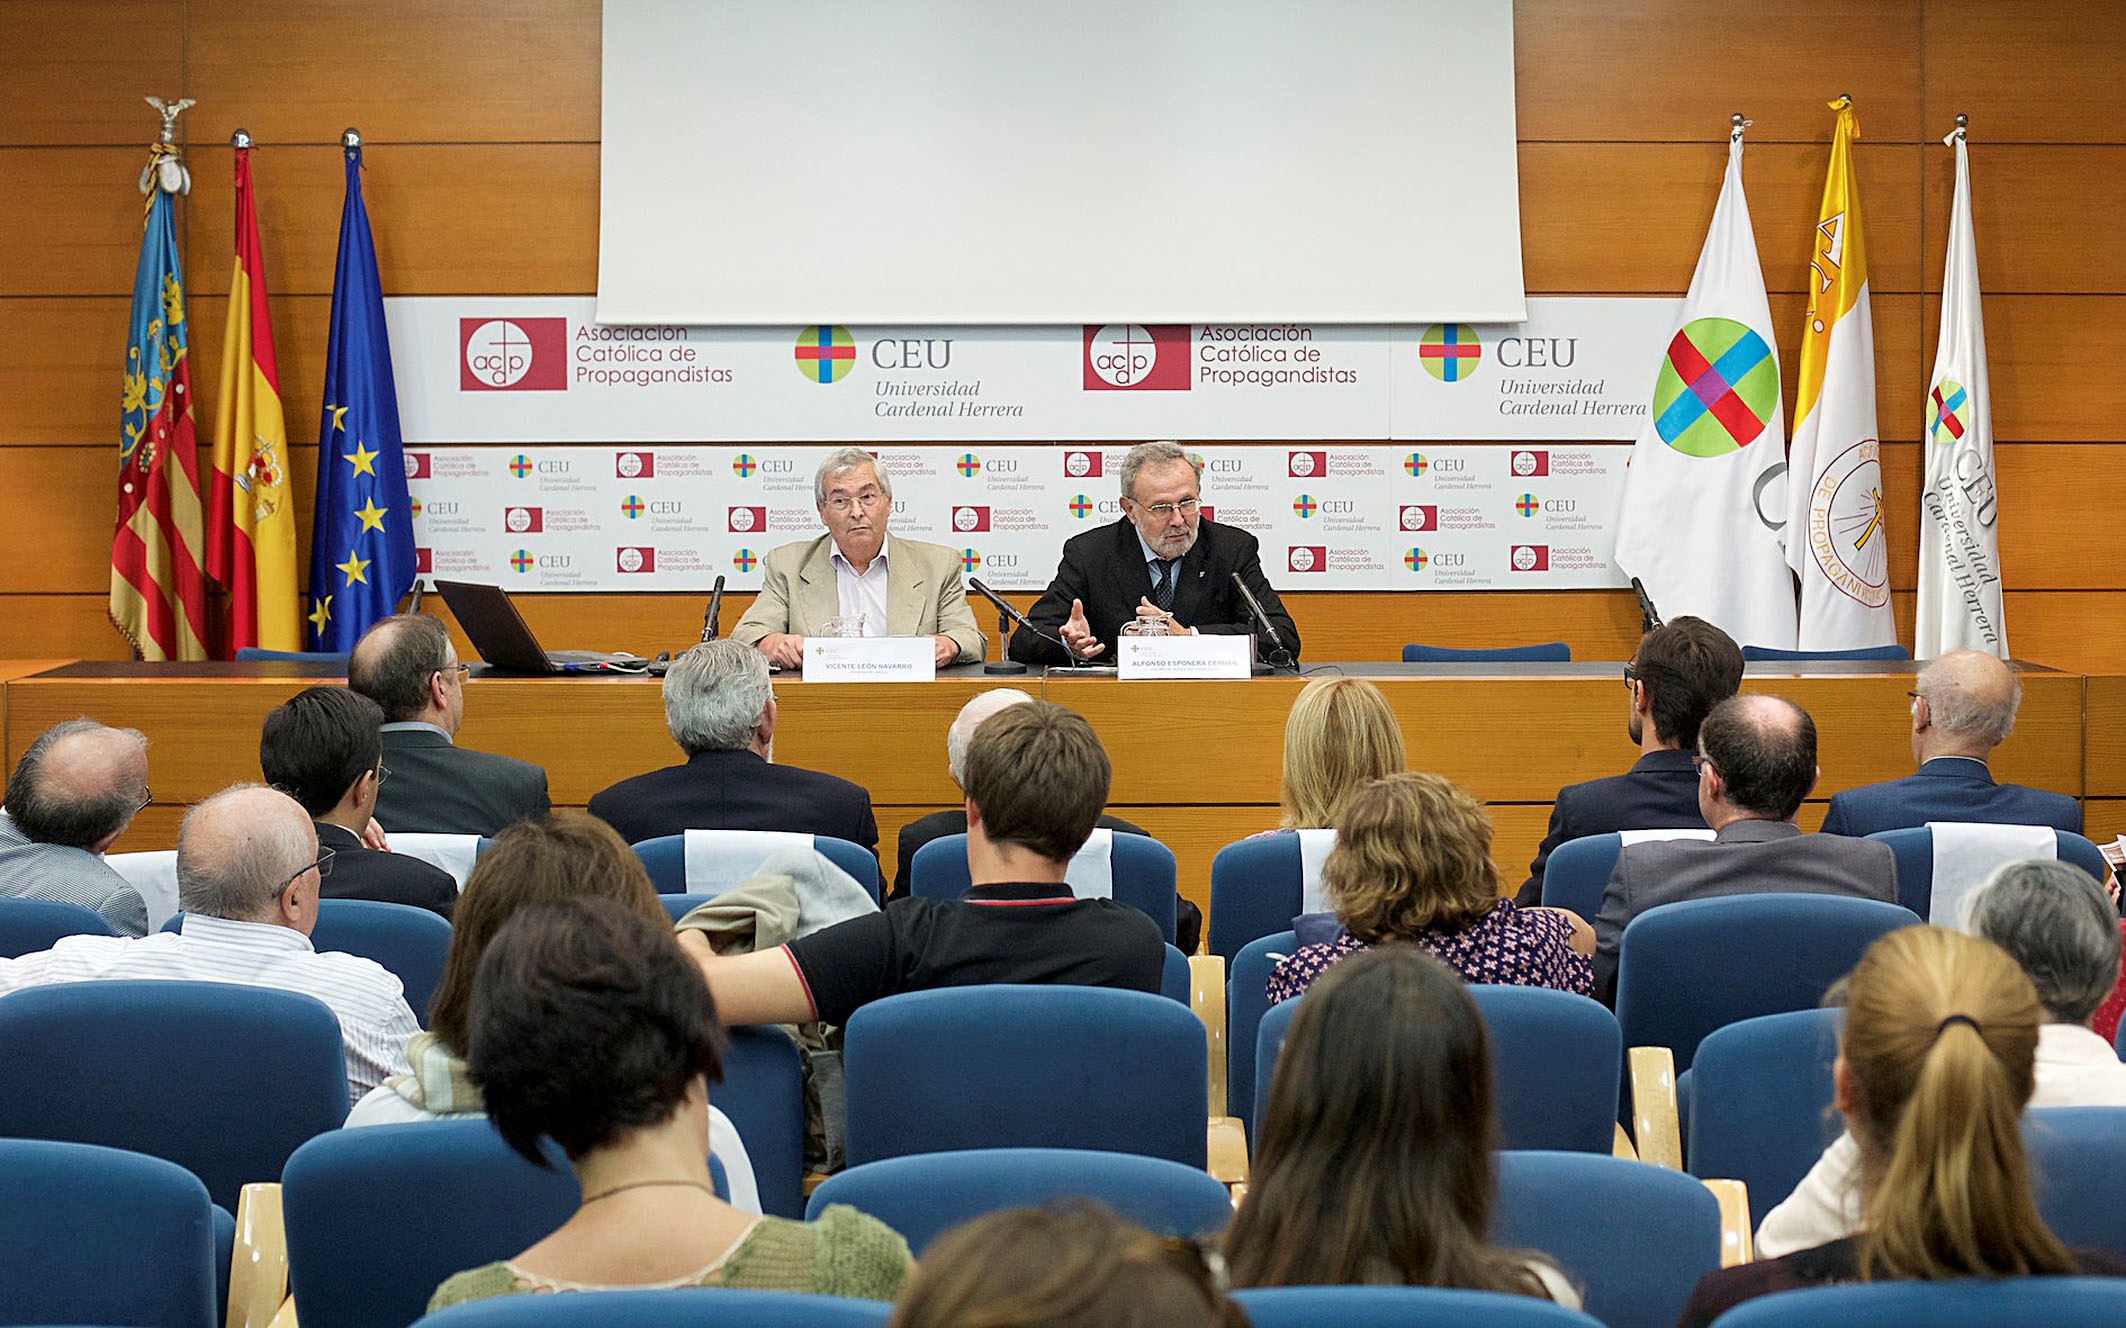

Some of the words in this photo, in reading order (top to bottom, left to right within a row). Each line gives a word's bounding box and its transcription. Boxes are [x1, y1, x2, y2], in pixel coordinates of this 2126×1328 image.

[576, 325, 688, 341] Asociación
[1200, 325, 1312, 341] Asociación
[576, 345, 662, 363] Católica
[669, 345, 696, 362] de
[872, 339, 954, 369] CEU
[1200, 345, 1286, 362] Católica
[1294, 345, 1321, 362] de
[1497, 338, 1579, 368] CEU
[576, 366, 733, 387] Propagandistas
[1200, 366, 1357, 387] Propagandistas
[875, 381, 981, 396] Universidad
[1500, 379, 1604, 395] Universidad
[875, 402, 954, 417] Cardenal
[959, 402, 1024, 417] Herrera
[1500, 400, 1578, 415] Cardenal
[1582, 400, 1647, 415] Herrera
[538, 461, 569, 473] CEU
[762, 460, 793, 472] CEU
[986, 460, 1017, 472] CEU
[1210, 460, 1241, 472] CEU
[1433, 459, 1464, 471] CEU
[1817, 476, 1838, 501] DE
[1956, 449, 1998, 529] CEU
[427, 502, 458, 514] CEU
[650, 502, 681, 514] CEU
[1322, 501, 1353, 513] CEU
[1544, 500, 1575, 512] CEU
[539, 556, 570, 568] CEU
[986, 555, 1017, 567] CEU
[1433, 554, 1464, 566] CEU
[1956, 573, 1998, 645] Herrera
